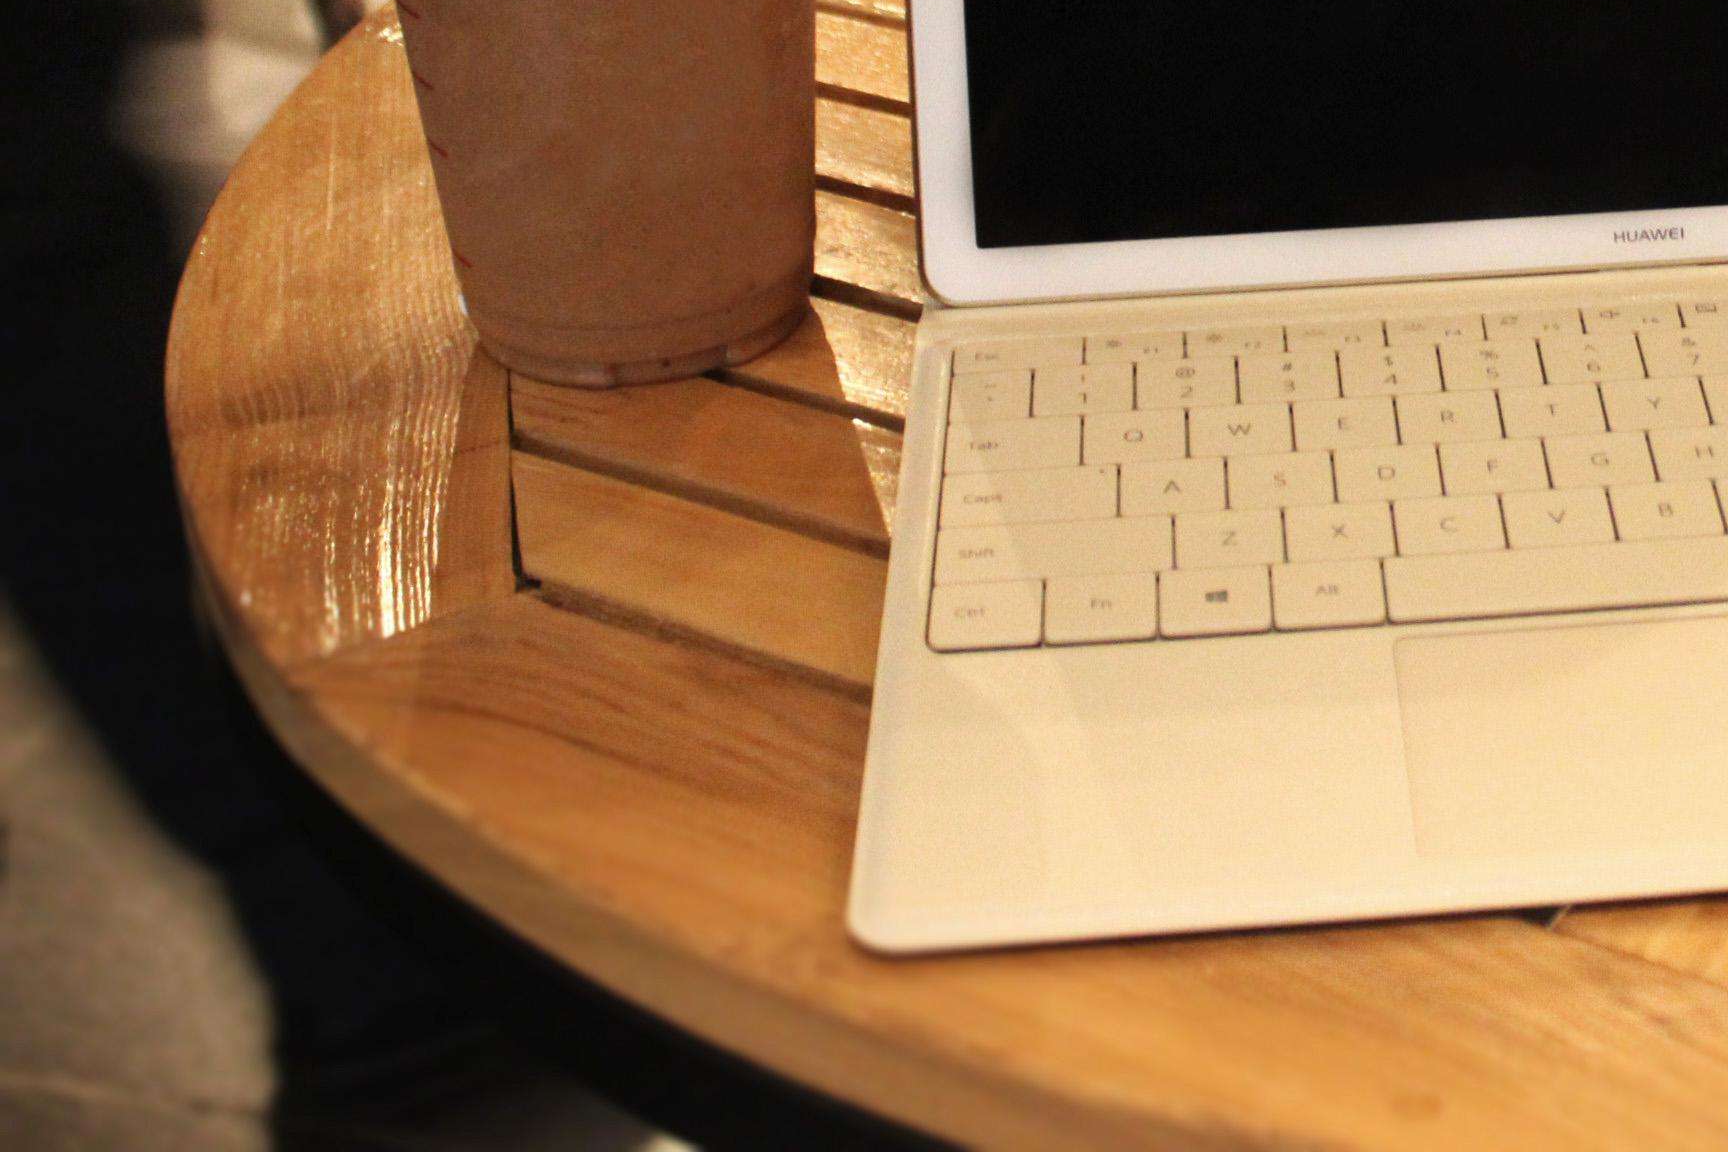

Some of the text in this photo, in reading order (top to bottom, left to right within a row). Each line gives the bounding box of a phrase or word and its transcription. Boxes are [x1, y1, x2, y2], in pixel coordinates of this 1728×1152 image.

[1613, 226, 1685, 244] HUAWEI
[1586, 360, 1600, 373] 6
[1688, 352, 1700, 366] 7
[1384, 373, 1398, 386] 4
[1180, 385, 1194, 398] 2
[1546, 403, 1557, 417] T
[1647, 397, 1661, 410] Y
[1337, 416, 1350, 431] E
[1440, 409, 1455, 424] R
[1226, 423, 1251, 437] W
[969, 440, 999, 451] Tab
[1694, 445, 1715, 459] H
[1486, 458, 1499, 475] F
[1590, 452, 1610, 467] G
[1273, 471, 1287, 488] S
[1376, 464, 1396, 482] D
[1162, 478, 1182, 494] A
[1547, 509, 1566, 525] V
[1656, 501, 1674, 518] B
[1331, 523, 1348, 539] X
[1439, 516, 1458, 534] C
[1220, 530, 1237, 547] Z
[957, 547, 995, 560] Shift
[1089, 598, 1114, 610] Fn
